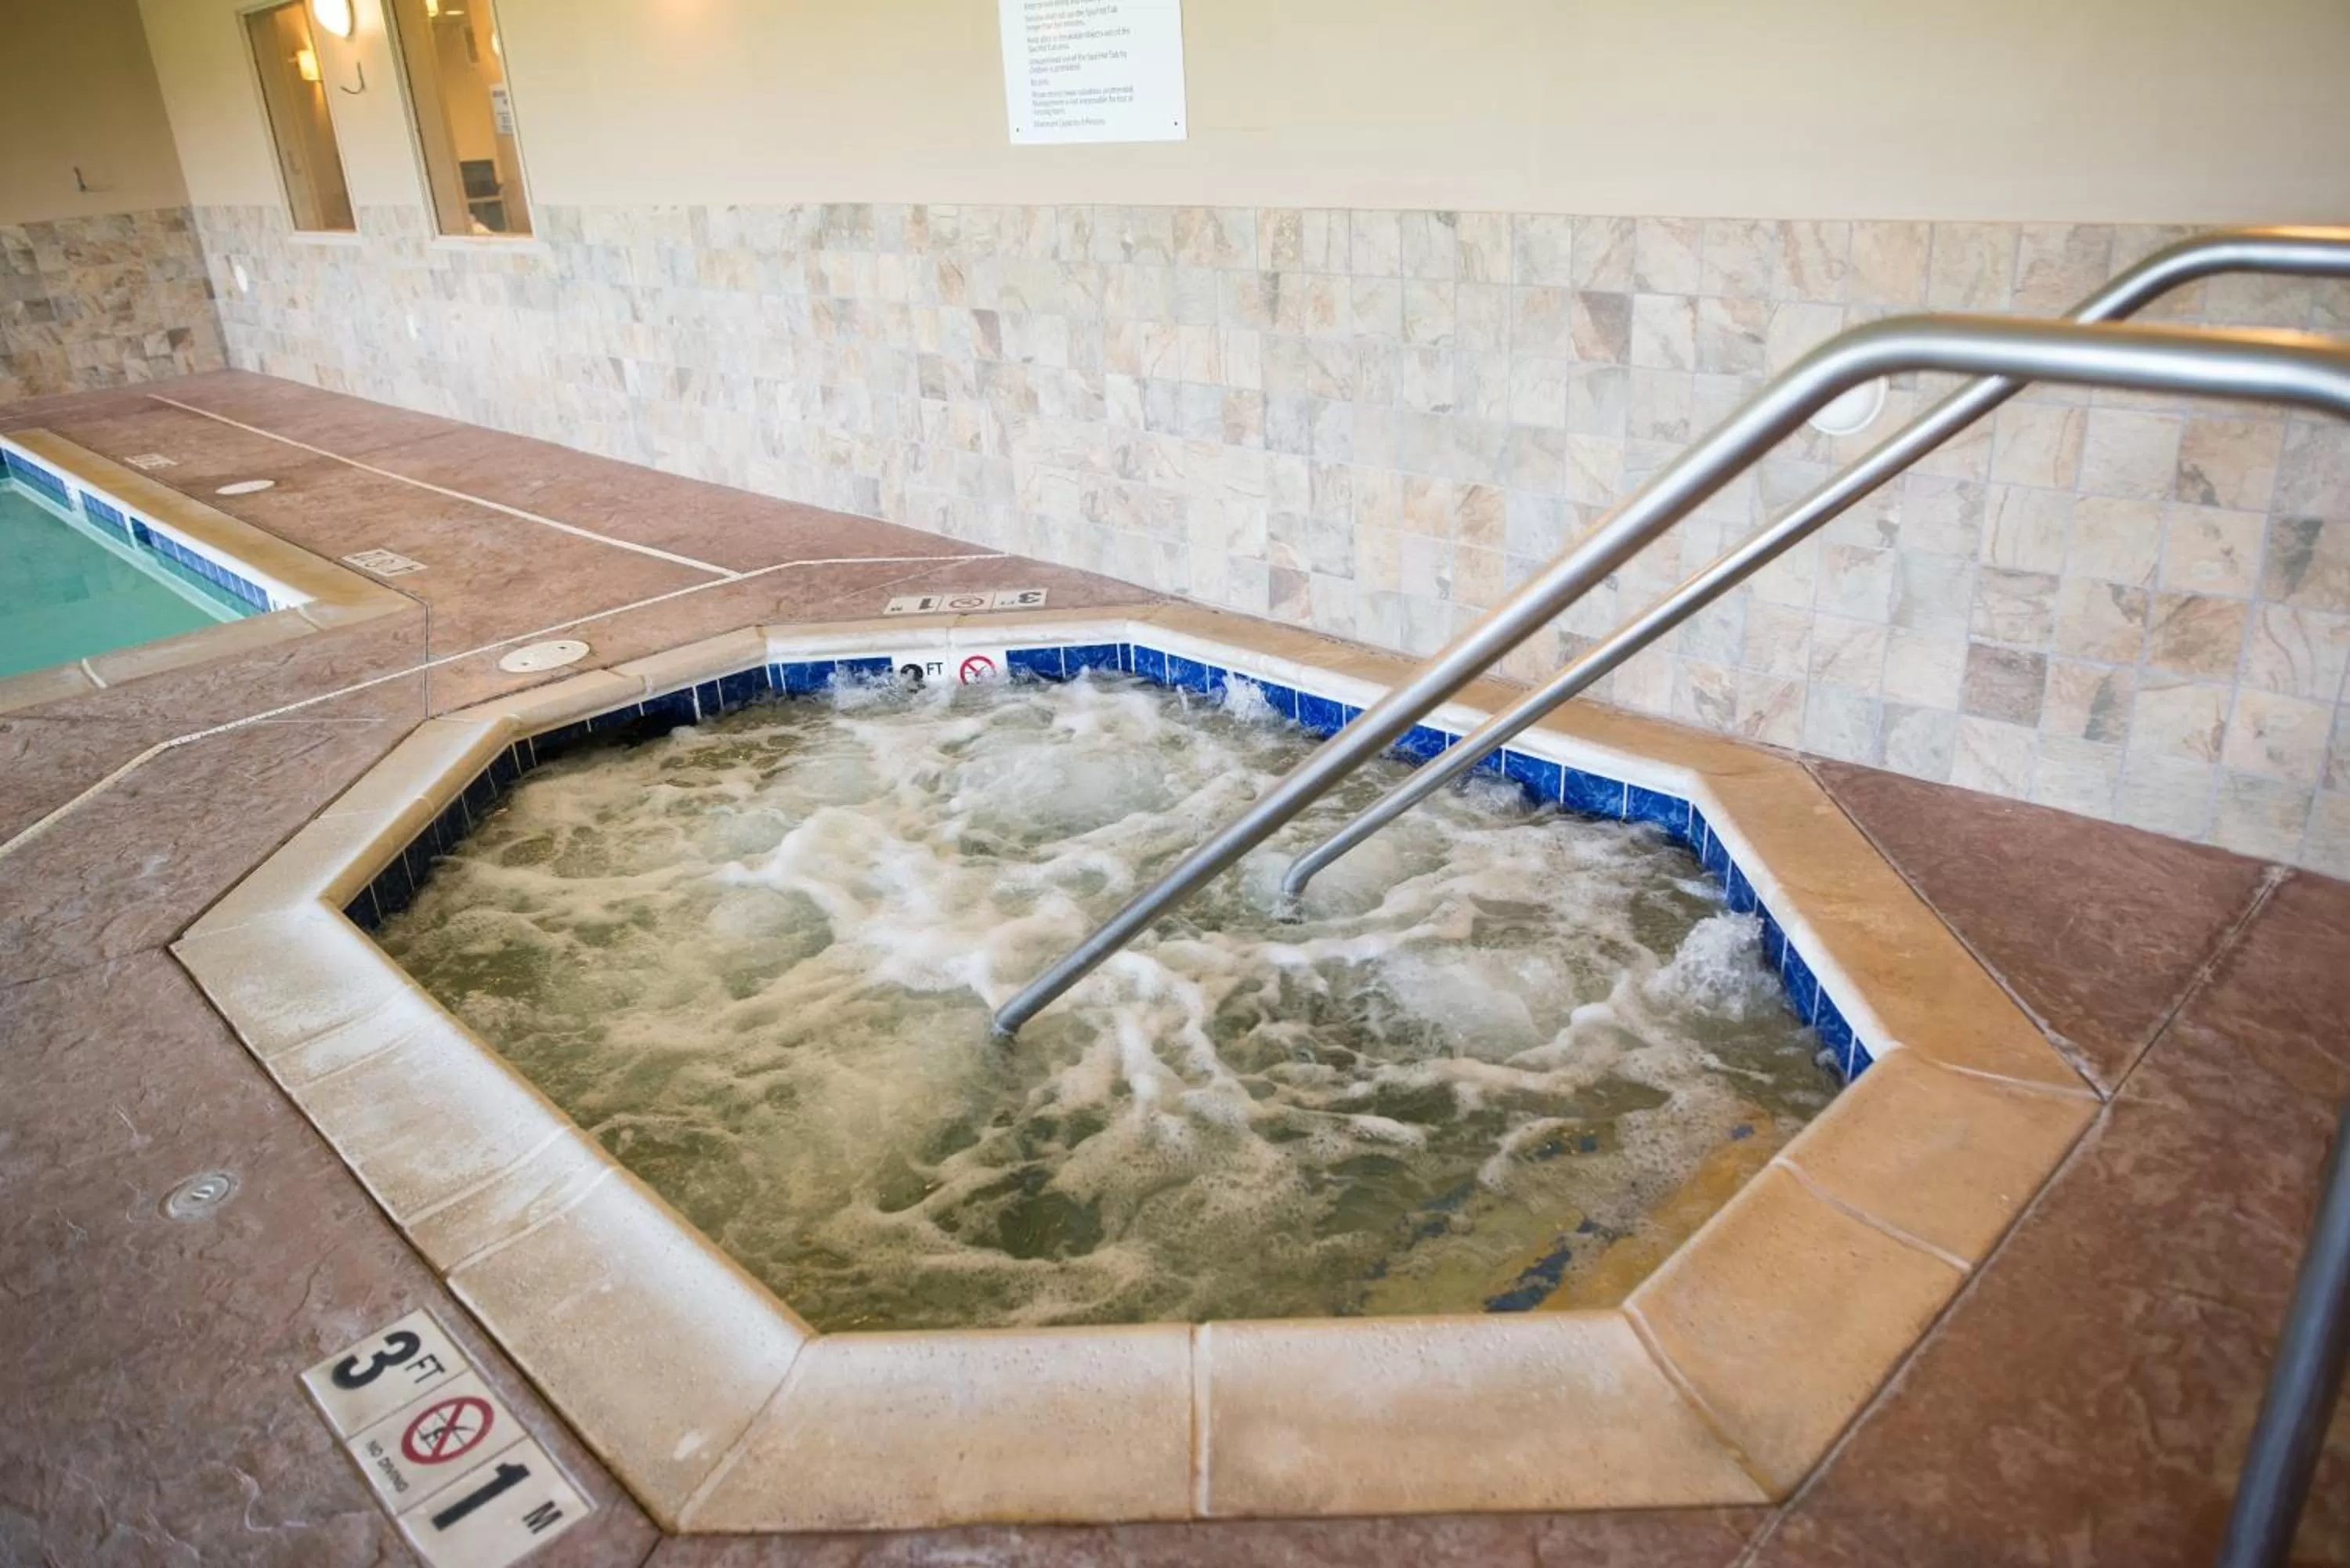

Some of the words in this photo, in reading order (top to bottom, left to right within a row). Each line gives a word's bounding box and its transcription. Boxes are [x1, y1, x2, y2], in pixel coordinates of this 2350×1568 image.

[927, 662, 943, 675] FT
[332, 1330, 421, 1390] 3
[404, 1353, 446, 1384] FT
[432, 1462, 531, 1532] 1
[522, 1500, 564, 1535] M
